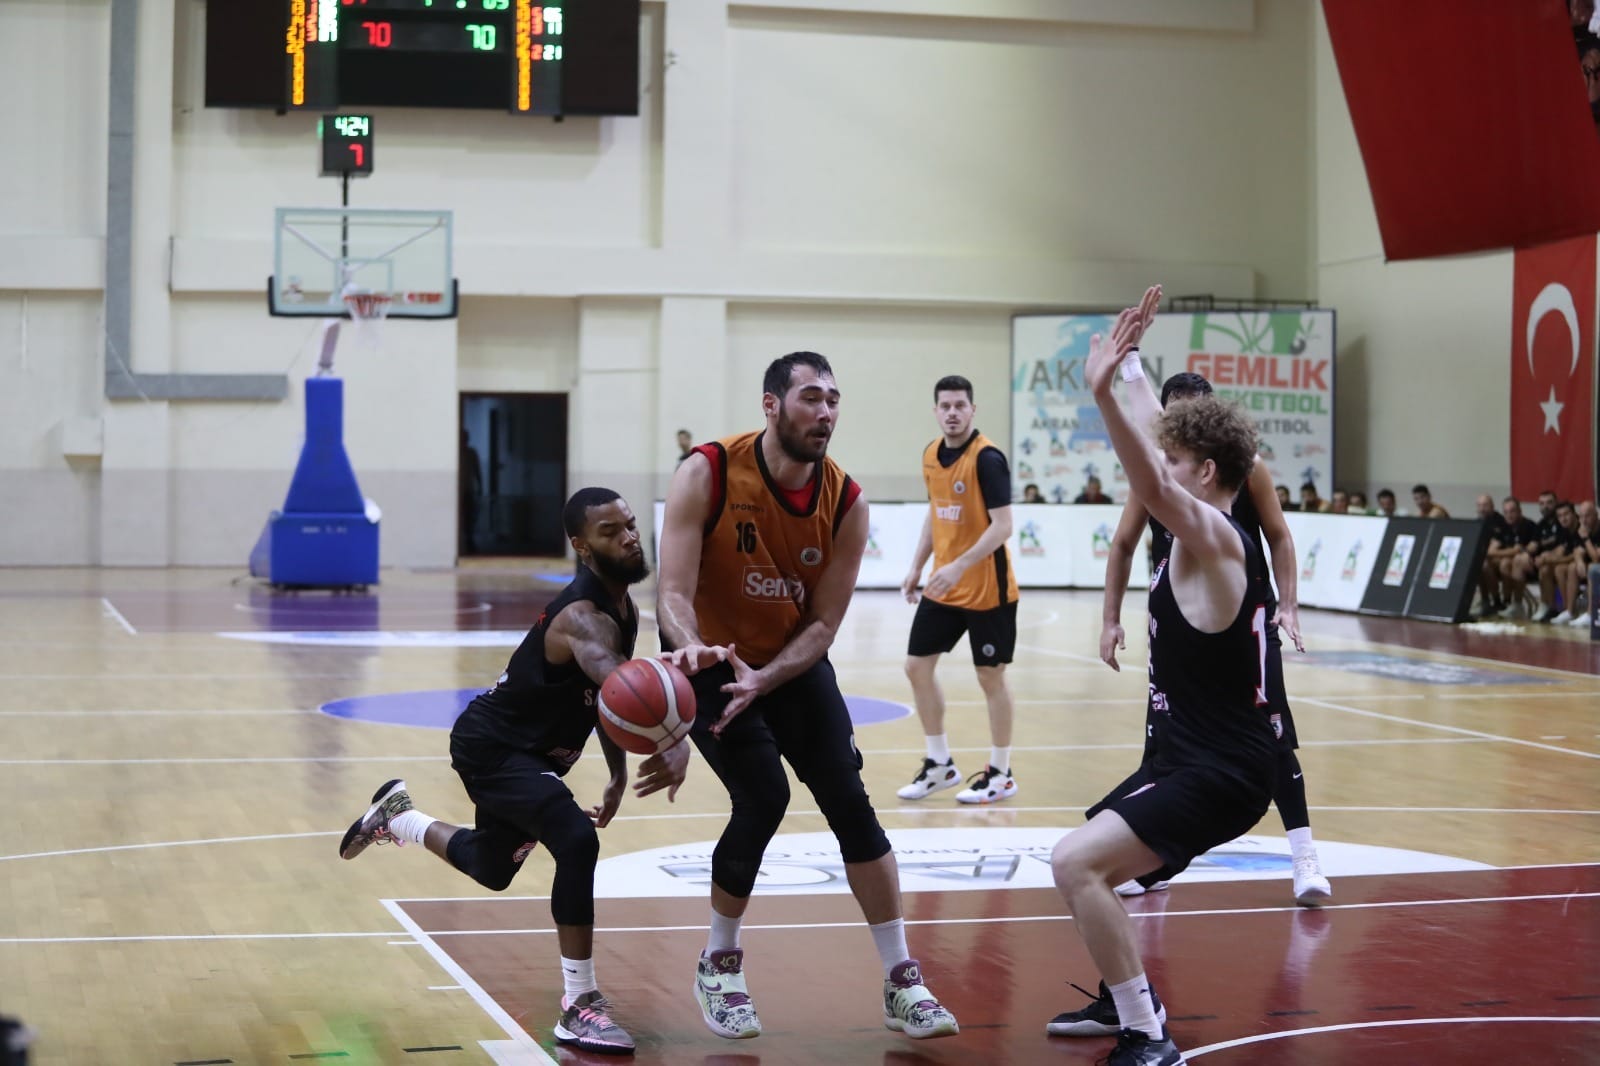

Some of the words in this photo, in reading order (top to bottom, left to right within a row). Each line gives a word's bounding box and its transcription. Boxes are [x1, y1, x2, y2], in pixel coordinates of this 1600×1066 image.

[362, 22, 391, 47] 70
[466, 24, 496, 51] 70
[349, 143, 364, 167] 7
[735, 521, 757, 555] 16
